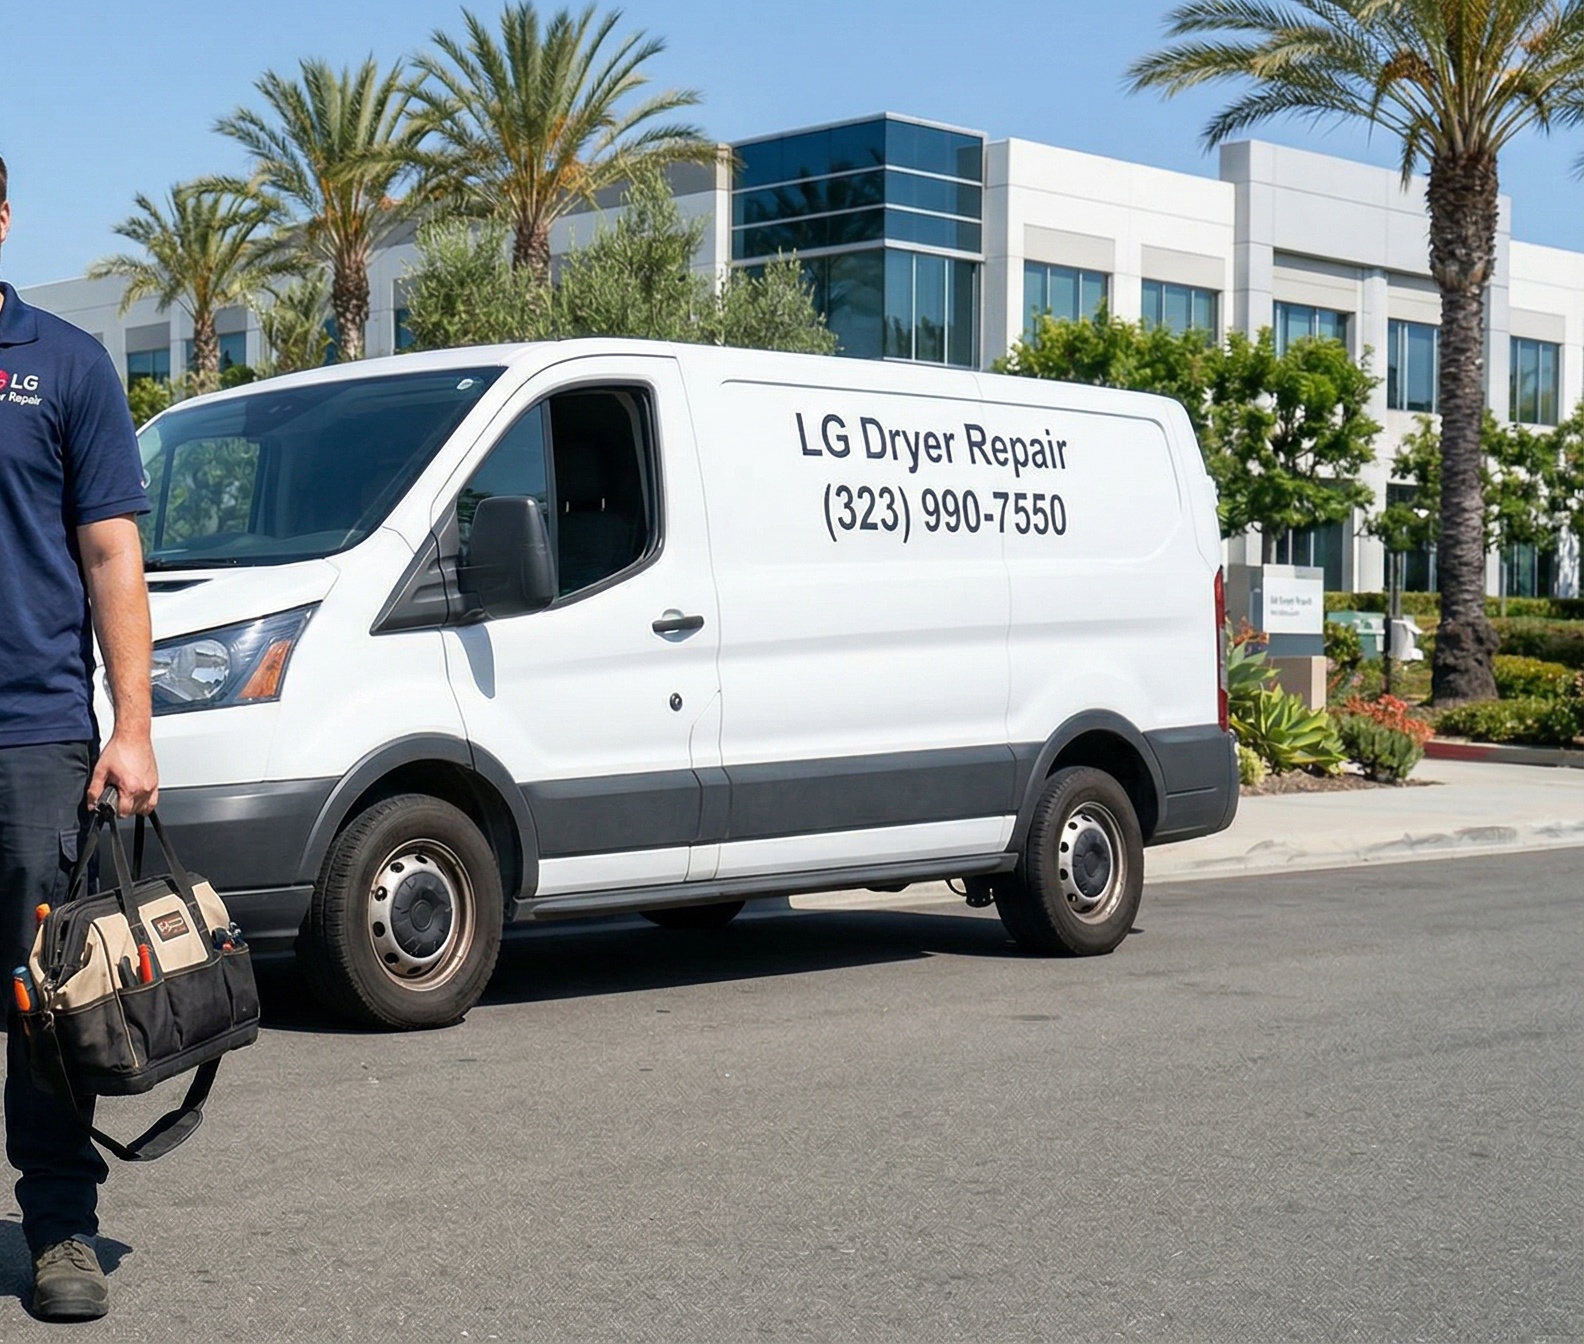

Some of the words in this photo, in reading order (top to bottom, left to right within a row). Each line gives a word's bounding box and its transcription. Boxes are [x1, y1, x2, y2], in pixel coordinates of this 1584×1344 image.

[9, 392, 42, 405] Repair
[10, 373, 39, 391] LG
[795, 412, 851, 459] LG
[859, 416, 956, 474] Dryer
[963, 423, 1068, 478] Repair
[823, 483, 911, 544] (323)
[921, 488, 1068, 536] 990-7550
